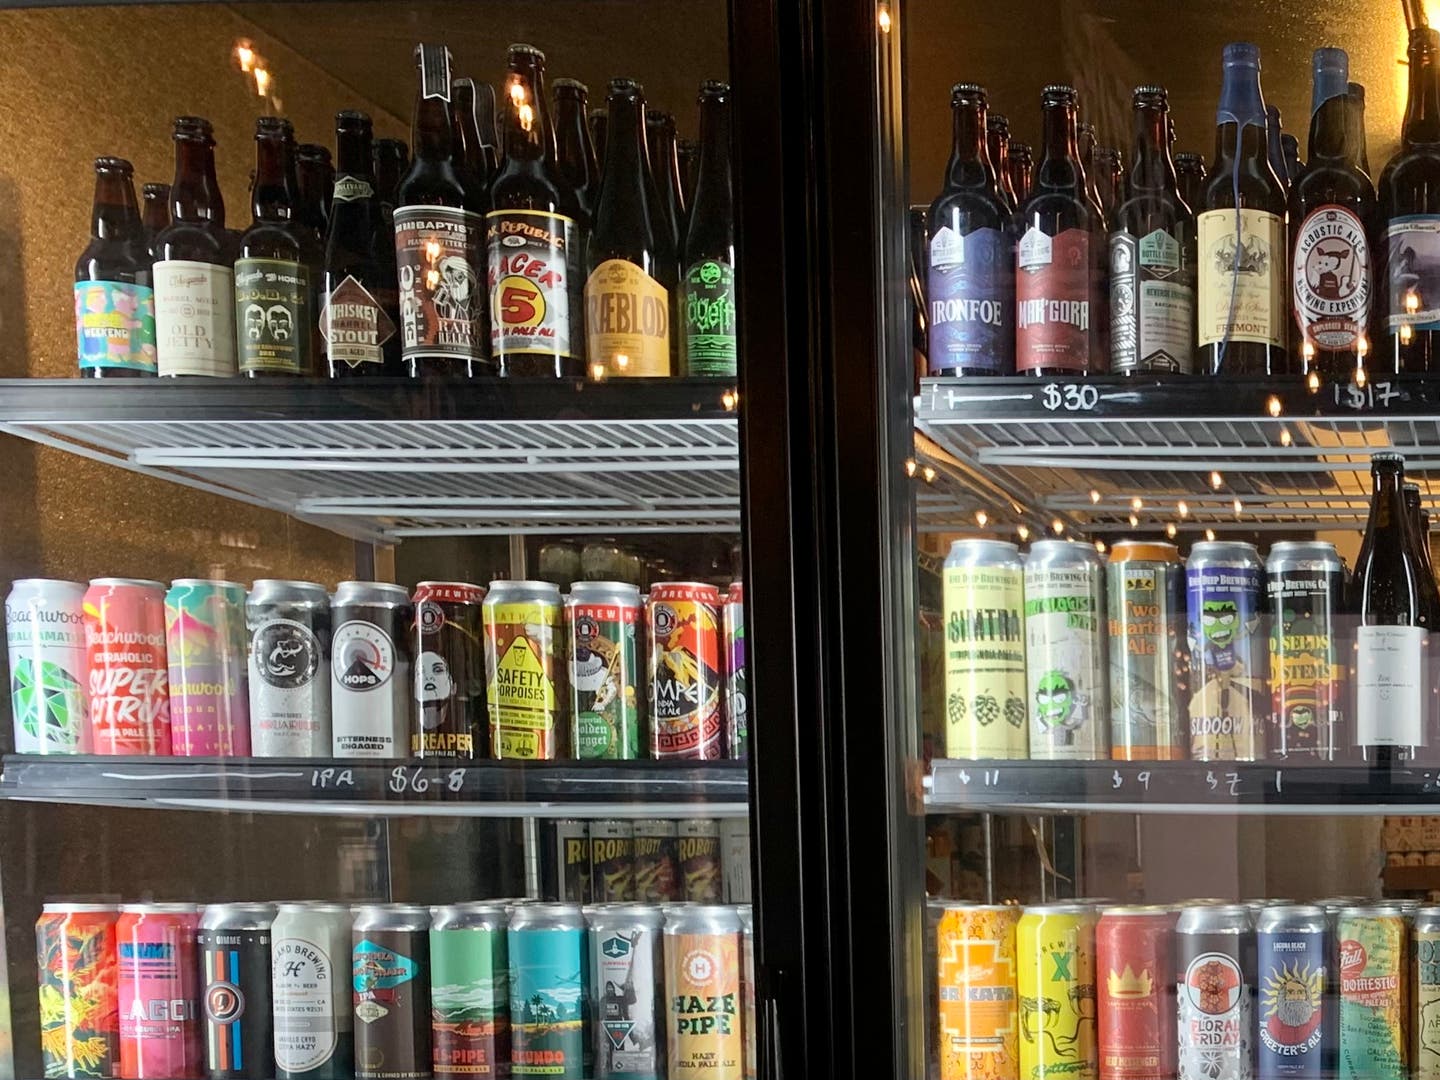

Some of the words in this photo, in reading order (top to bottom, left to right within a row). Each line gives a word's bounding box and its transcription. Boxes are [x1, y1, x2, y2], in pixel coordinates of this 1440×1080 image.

[501, 221, 565, 249] REPUBLIC
[1301, 225, 1344, 254] ACOUSTIC
[1346, 230, 1366, 254] ALES
[501, 286, 538, 324] 5
[932, 299, 1004, 327] IRONFOE
[84, 328, 128, 339] WEEKEND
[171, 326, 206, 338] OLD
[330, 329, 379, 344] STOUT
[1216, 323, 1269, 334] FREMONT
[1043, 384, 1099, 411] $30
[1349, 382, 1400, 410] $17
[1125, 601, 1160, 618] Two
[1126, 637, 1157, 655] Ale
[1281, 634, 1330, 651] SEEDS
[94, 652, 153, 664] CITRAHOLIC
[343, 675, 377, 685] HOPS
[497, 667, 544, 686] SAFETY
[1282, 664, 1332, 681] STEMS
[89, 667, 169, 696] SUPER
[91, 698, 171, 724] CITRUS
[122, 728, 145, 738] PALE
[424, 734, 473, 751] REAPER
[311, 768, 355, 789] IPA
[294, 945, 327, 981] BREWING
[1343, 975, 1397, 992] DOMESTIC
[672, 992, 736, 1016] HAZE
[677, 1014, 733, 1035] PIPE
[1191, 1019, 1240, 1033] FLORAL
[1192, 1032, 1241, 1046] FRIDAY
[1259, 1027, 1307, 1057] GREETER'S
[1307, 1031, 1323, 1051] ALE
[692, 1052, 716, 1060] HAZY
